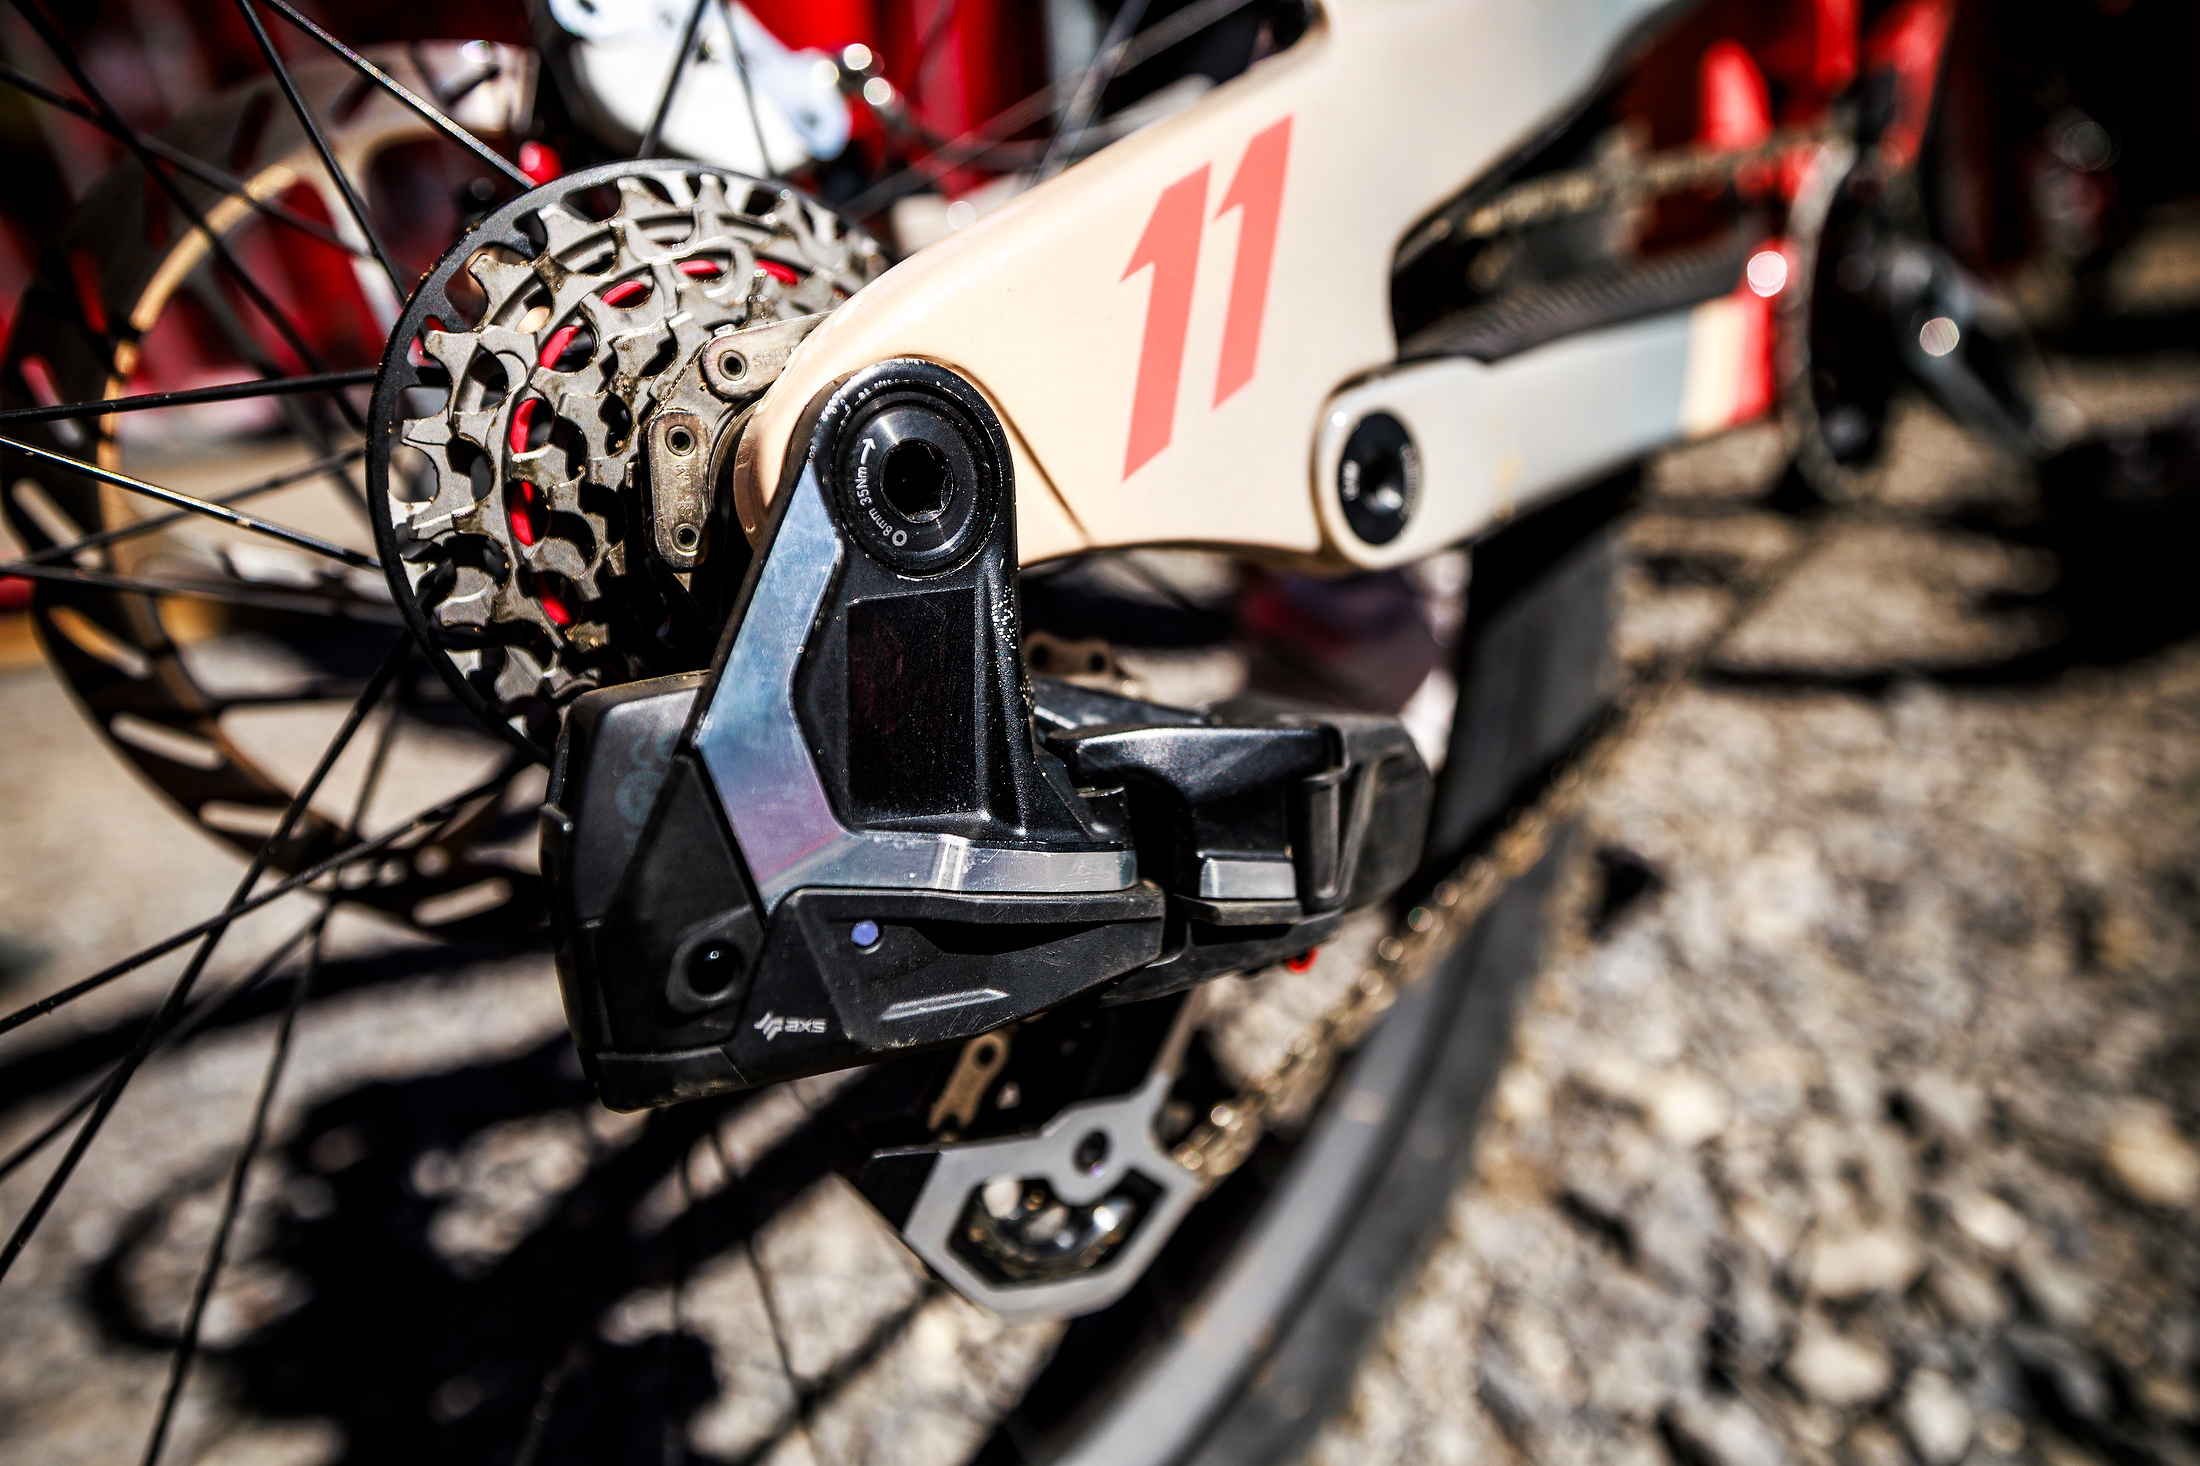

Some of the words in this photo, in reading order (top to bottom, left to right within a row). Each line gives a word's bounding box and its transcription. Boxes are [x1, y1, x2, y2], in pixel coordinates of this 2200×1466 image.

[1118, 112, 1294, 482] 11
[855, 466, 872, 507] 35Nm
[868, 507, 893, 536] 8mm
